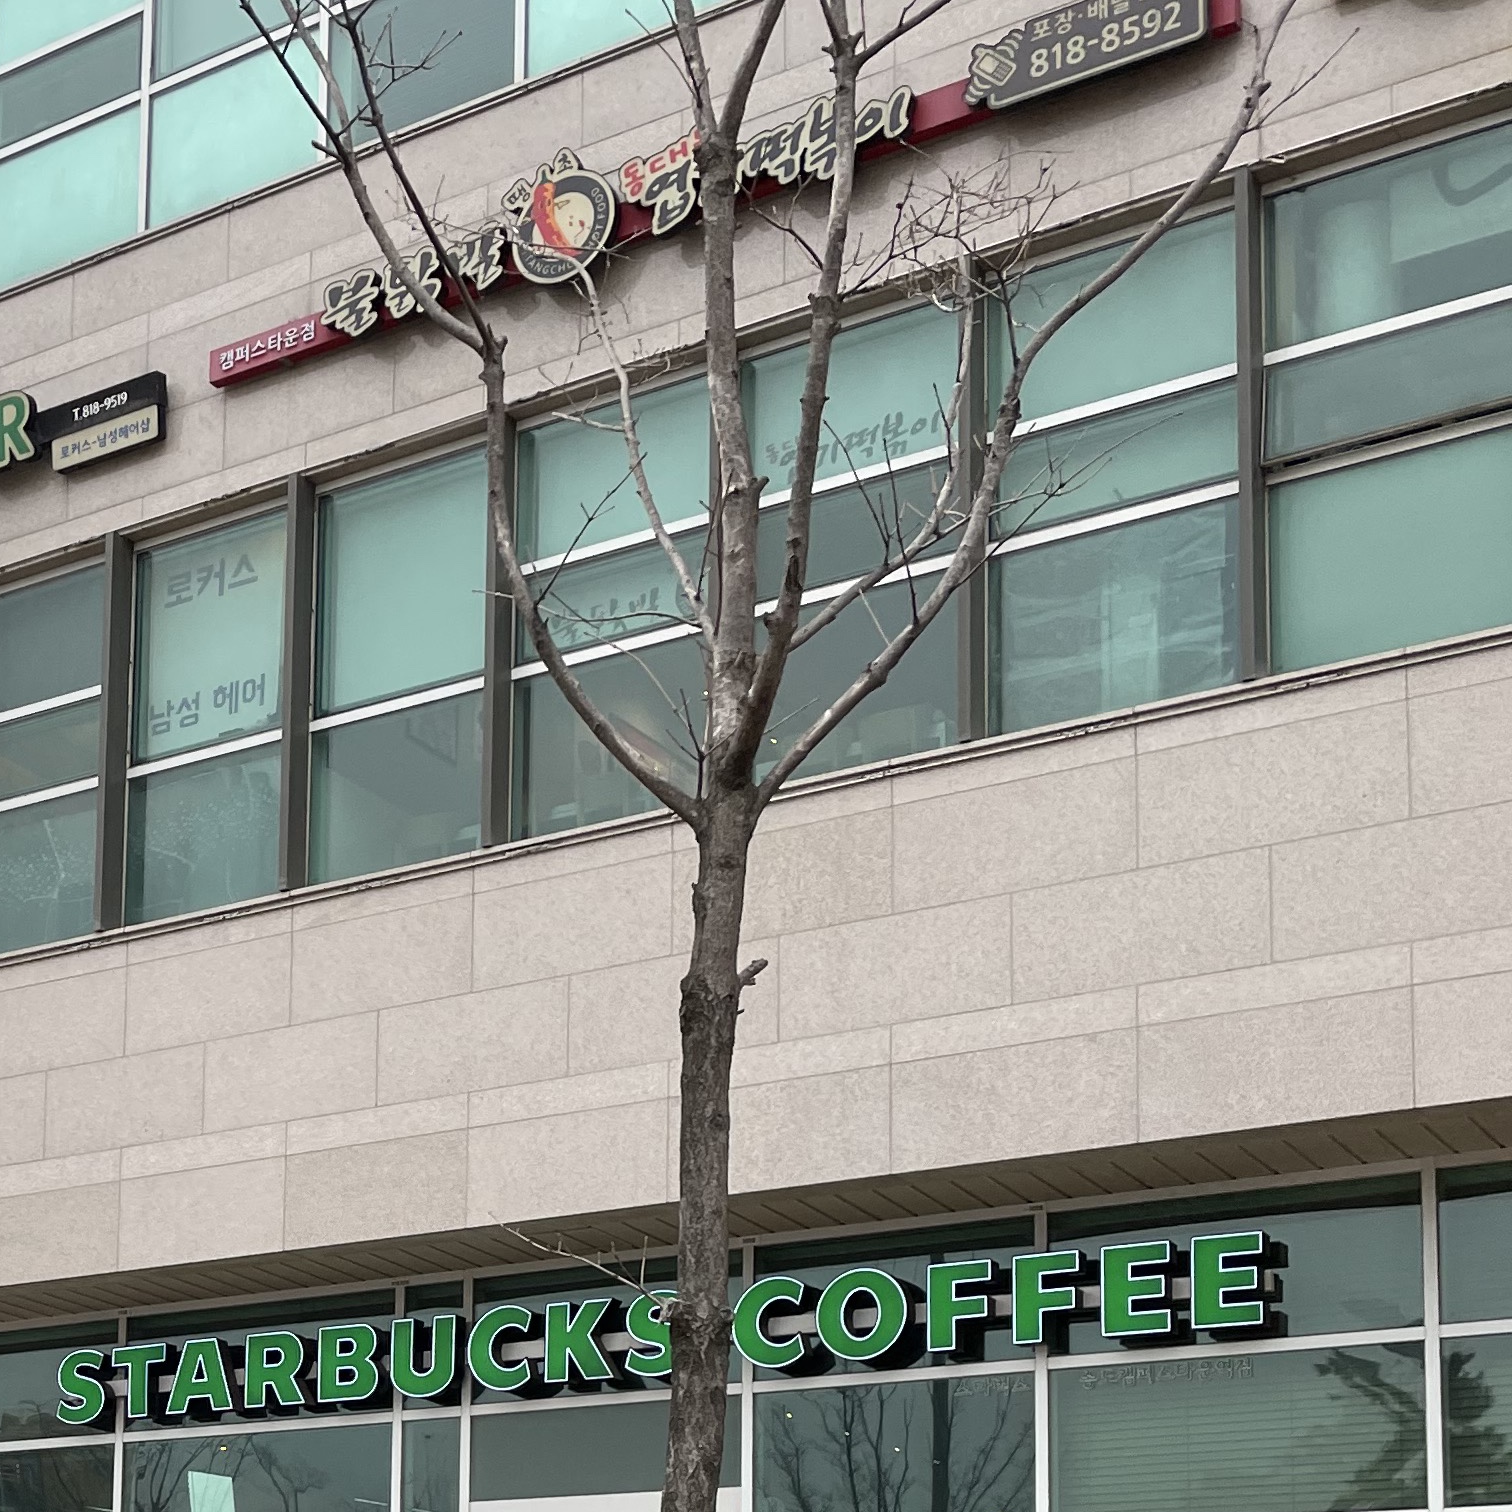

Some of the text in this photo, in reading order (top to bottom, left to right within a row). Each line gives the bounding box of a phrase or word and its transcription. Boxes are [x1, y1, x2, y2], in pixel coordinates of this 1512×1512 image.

[1029, 2, 1182, 77] 818-8592
[219, 319, 316, 371] 캠퍼스타운점
[71, 391, 128, 421] T.818-9519
[164, 554, 259, 608] 로커스
[149, 672, 266, 737] 남성 헤어
[56, 1230, 1265, 1426] STARBUCKS COFFEE
